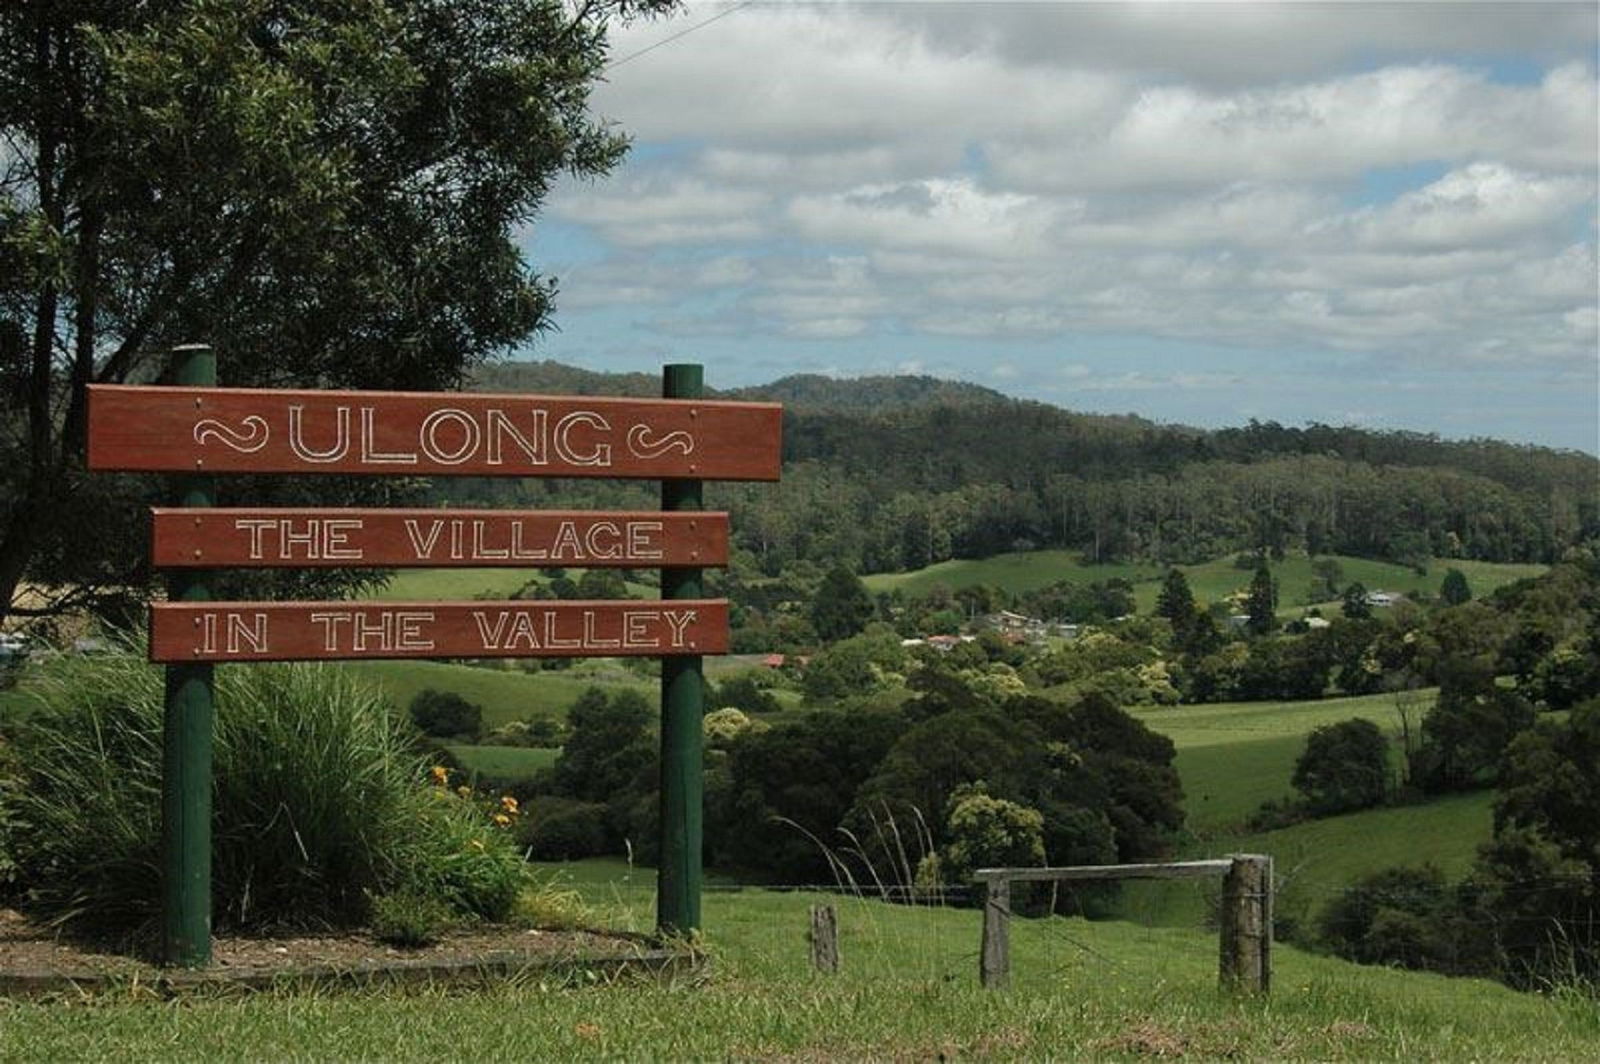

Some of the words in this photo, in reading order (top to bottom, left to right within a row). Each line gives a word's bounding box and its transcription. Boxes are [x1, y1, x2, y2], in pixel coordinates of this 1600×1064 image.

[289, 405, 611, 467] ULONG
[235, 519, 363, 560] THE
[405, 519, 663, 560] VILLAGE
[203, 613, 268, 654] IN
[311, 611, 435, 652] THE
[473, 610, 696, 650] VALLEY
